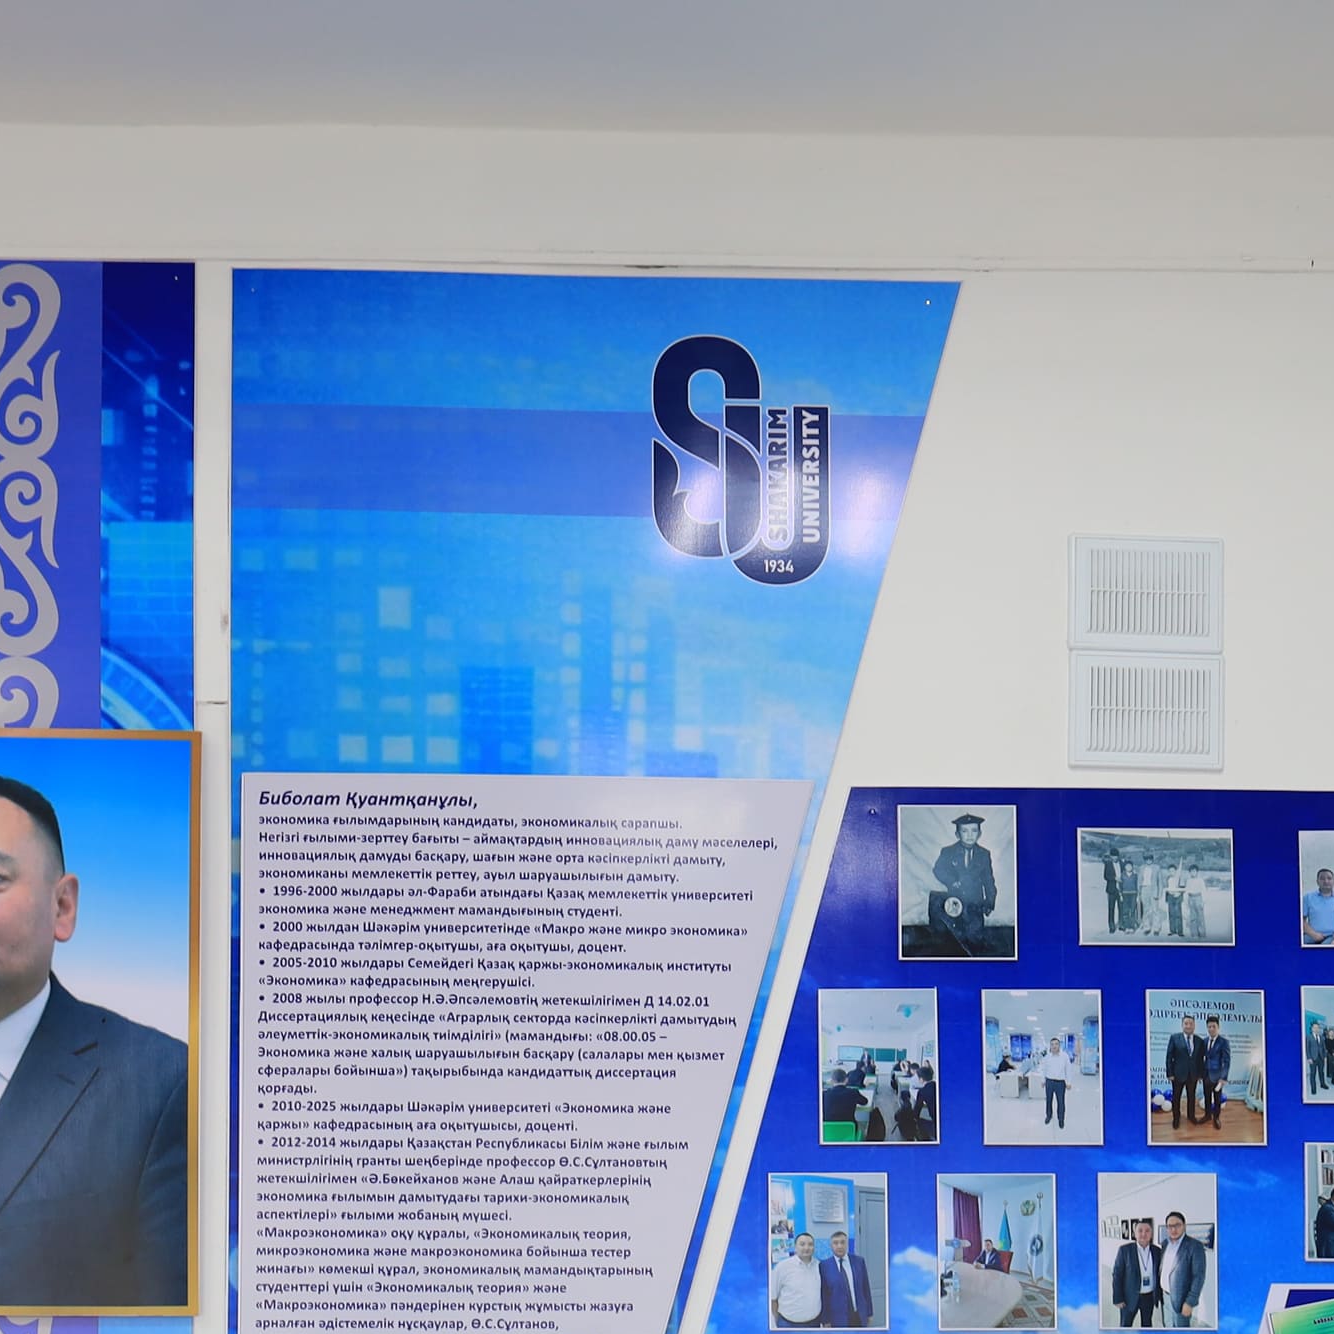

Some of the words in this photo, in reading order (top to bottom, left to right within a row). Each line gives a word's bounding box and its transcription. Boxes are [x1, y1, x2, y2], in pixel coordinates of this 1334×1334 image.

[767, 407, 789, 543] SHAKARIM
[802, 409, 821, 544] UNIVERSITY
[763, 559, 794, 573] 1934
[259, 791, 341, 805] Биболат
[345, 791, 477, 811] Қуантқанұлы,
[259, 868, 349, 880] экономиканы
[351, 867, 433, 881] мемлекеттік
[435, 870, 479, 883] реттеу,
[483, 870, 515, 884] ауыл
[519, 870, 623, 885] шаруашылығын
[627, 871, 679, 885] дамыту.
[273, 884, 337, 898] 1996-2000
[341, 887, 405, 901] жылдары
[407, 885, 477, 901] әл-Фараби
[479, 888, 543, 902] атындағы
[547, 887, 585, 902] Қазақ
[587, 887, 667, 901] мемлекеттік
[671, 888, 753, 904] университеті
[259, 904, 329, 916] экономика
[333, 905, 367, 916] және
[369, 905, 455, 919] менеджмент
[459, 906, 565, 920] мамандығының
[567, 905, 623, 920] студенті.
[273, 920, 303, 933] 2000
[305, 922, 359, 936] жылдан
[363, 921, 421, 937] Шәкәрім
[423, 921, 531, 938] университетінде
[533, 922, 585, 938] «Макро
[589, 925, 621, 936] және
[625, 925, 667, 939] микро
[671, 925, 747, 937] экономика»
[259, 938, 355, 954] кафедрасында
[487, 942, 507, 953] аға
[509, 942, 575, 956] оқытушы,
[577, 943, 627, 956] доцент.
[273, 956, 337, 970] 2005-2010
[341, 959, 405, 973] жылдары
[407, 957, 473, 973] Семейдегі
[477, 958, 515, 973] Қазақ
[519, 960, 663, 975] қаржы-экономикалық
[667, 961, 731, 975] институты
[259, 974, 347, 988] «Экономика»
[351, 975, 451, 991] кафедрасының
[453, 975, 535, 991] меңгерушісі.
[273, 992, 303, 1005] 2008
[305, 994, 345, 1006] жылы
[349, 993, 419, 1009] профессор
[541, 994, 641, 1008] жетекшілігімен
[643, 995, 655, 1010] Д
[659, 995, 709, 1008] 14.02.01
[257, 1028, 431, 1045] әлеуметтік-экономикалық
[433, 1029, 501, 1045] тиімділігі»
[257, 1046, 331, 1060] Экономика
[333, 1049, 367, 1060] және
[371, 1049, 413, 1062] халық
[415, 1049, 519, 1063] шаруашылығын
[523, 1048, 575, 1063] басқару
[577, 1048, 643, 1064] (салалары
[647, 1051, 673, 1062] мен
[677, 1051, 725, 1064] қызмет
[257, 1064, 331, 1080] сфералары
[411, 1065, 503, 1081] тақырыбында
[507, 1068, 593, 1082] кандидаттық
[595, 1068, 677, 1082] диссертация
[257, 1084, 317, 1098] қорғады.
[271, 1100, 337, 1114] 2010-2025
[339, 1103, 403, 1116] жылдары
[407, 1101, 465, 1117] Шәкәрім
[467, 1101, 551, 1117] университеті
[555, 1102, 635, 1115] «Экономика
[637, 1104, 671, 1115] және
[257, 1120, 309, 1134] қаржы»
[313, 1118, 413, 1134] кафедрасының
[417, 1121, 437, 1132] аға
[439, 1121, 521, 1135] оқытушысы,
[525, 1120, 577, 1135] доценті.
[271, 1136, 337, 1149] 2012-2014
[339, 1139, 403, 1152] жылдары
[407, 1137, 471, 1153] Қазақстан
[475, 1137, 567, 1153] Республикасы
[571, 1138, 603, 1151] Білім
[607, 1140, 641, 1151] және
[643, 1140, 689, 1151] ғылым
[257, 1154, 353, 1170] министрлігінің
[357, 1157, 401, 1170] гранты
[405, 1155, 483, 1171] шеңберінде
[487, 1155, 555, 1171] профессор
[257, 1208, 337, 1224] аспектілері»
[341, 1210, 395, 1222] ғылыми
[397, 1209, 459, 1224] жобаның
[463, 1209, 511, 1225] мүшесі.
[257, 1226, 387, 1242] «Макроэкономика»
[391, 1229, 415, 1242] оқу
[417, 1229, 469, 1242] құралы,
[473, 1227, 581, 1243] «Экономикалық
[583, 1229, 631, 1243] теория,
[255, 1246, 369, 1260] микроэкономика
[373, 1247, 407, 1258] және
[411, 1247, 523, 1261] макроэкономика
[527, 1245, 587, 1258] бойынша
[591, 1247, 631, 1261] тестер
[255, 1280, 329, 1296] студенттері
[333, 1280, 363, 1296] үшін
[367, 1281, 475, 1296] «Экономикалық
[477, 1283, 529, 1296] теория»
[533, 1283, 567, 1294] және
[255, 1298, 387, 1314] «Макроэкономика»
[391, 1299, 465, 1314] пәндерінен
[469, 1301, 523, 1314] курстық
[525, 1301, 587, 1315] жұмысты
[589, 1301, 633, 1315] жазуға
